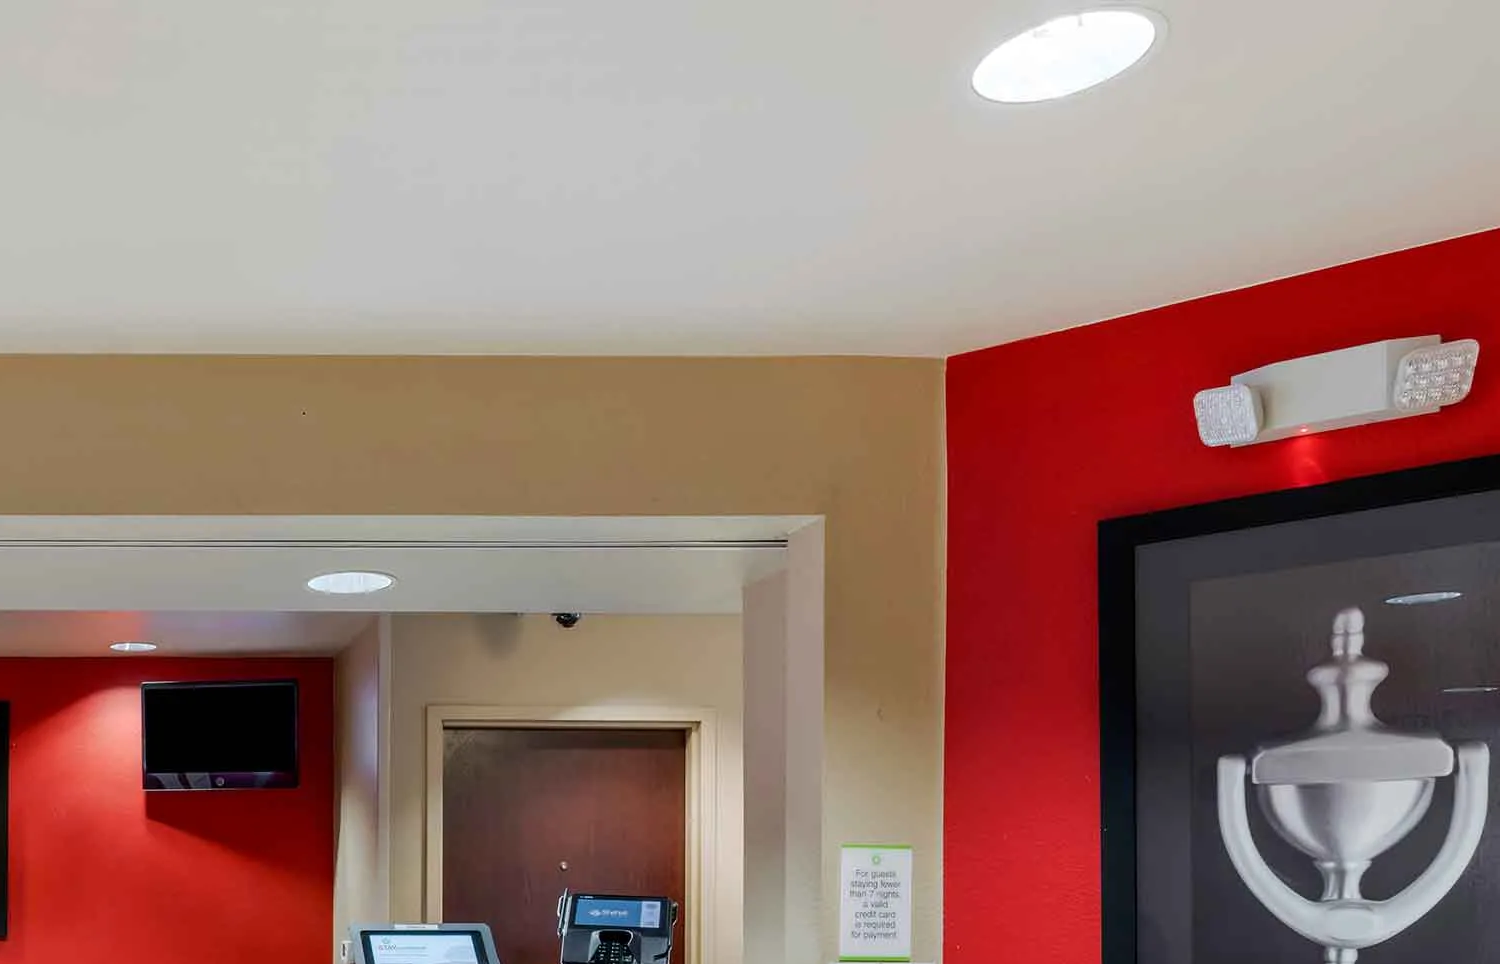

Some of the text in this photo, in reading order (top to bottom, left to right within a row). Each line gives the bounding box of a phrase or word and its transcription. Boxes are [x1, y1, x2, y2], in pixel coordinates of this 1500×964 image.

[855, 869, 869, 878] For
[851, 880, 878, 890] staying
[870, 900, 889, 909] valid
[855, 911, 896, 919] credit card
[864, 921, 896, 931] required
[851, 930, 861, 938] for
